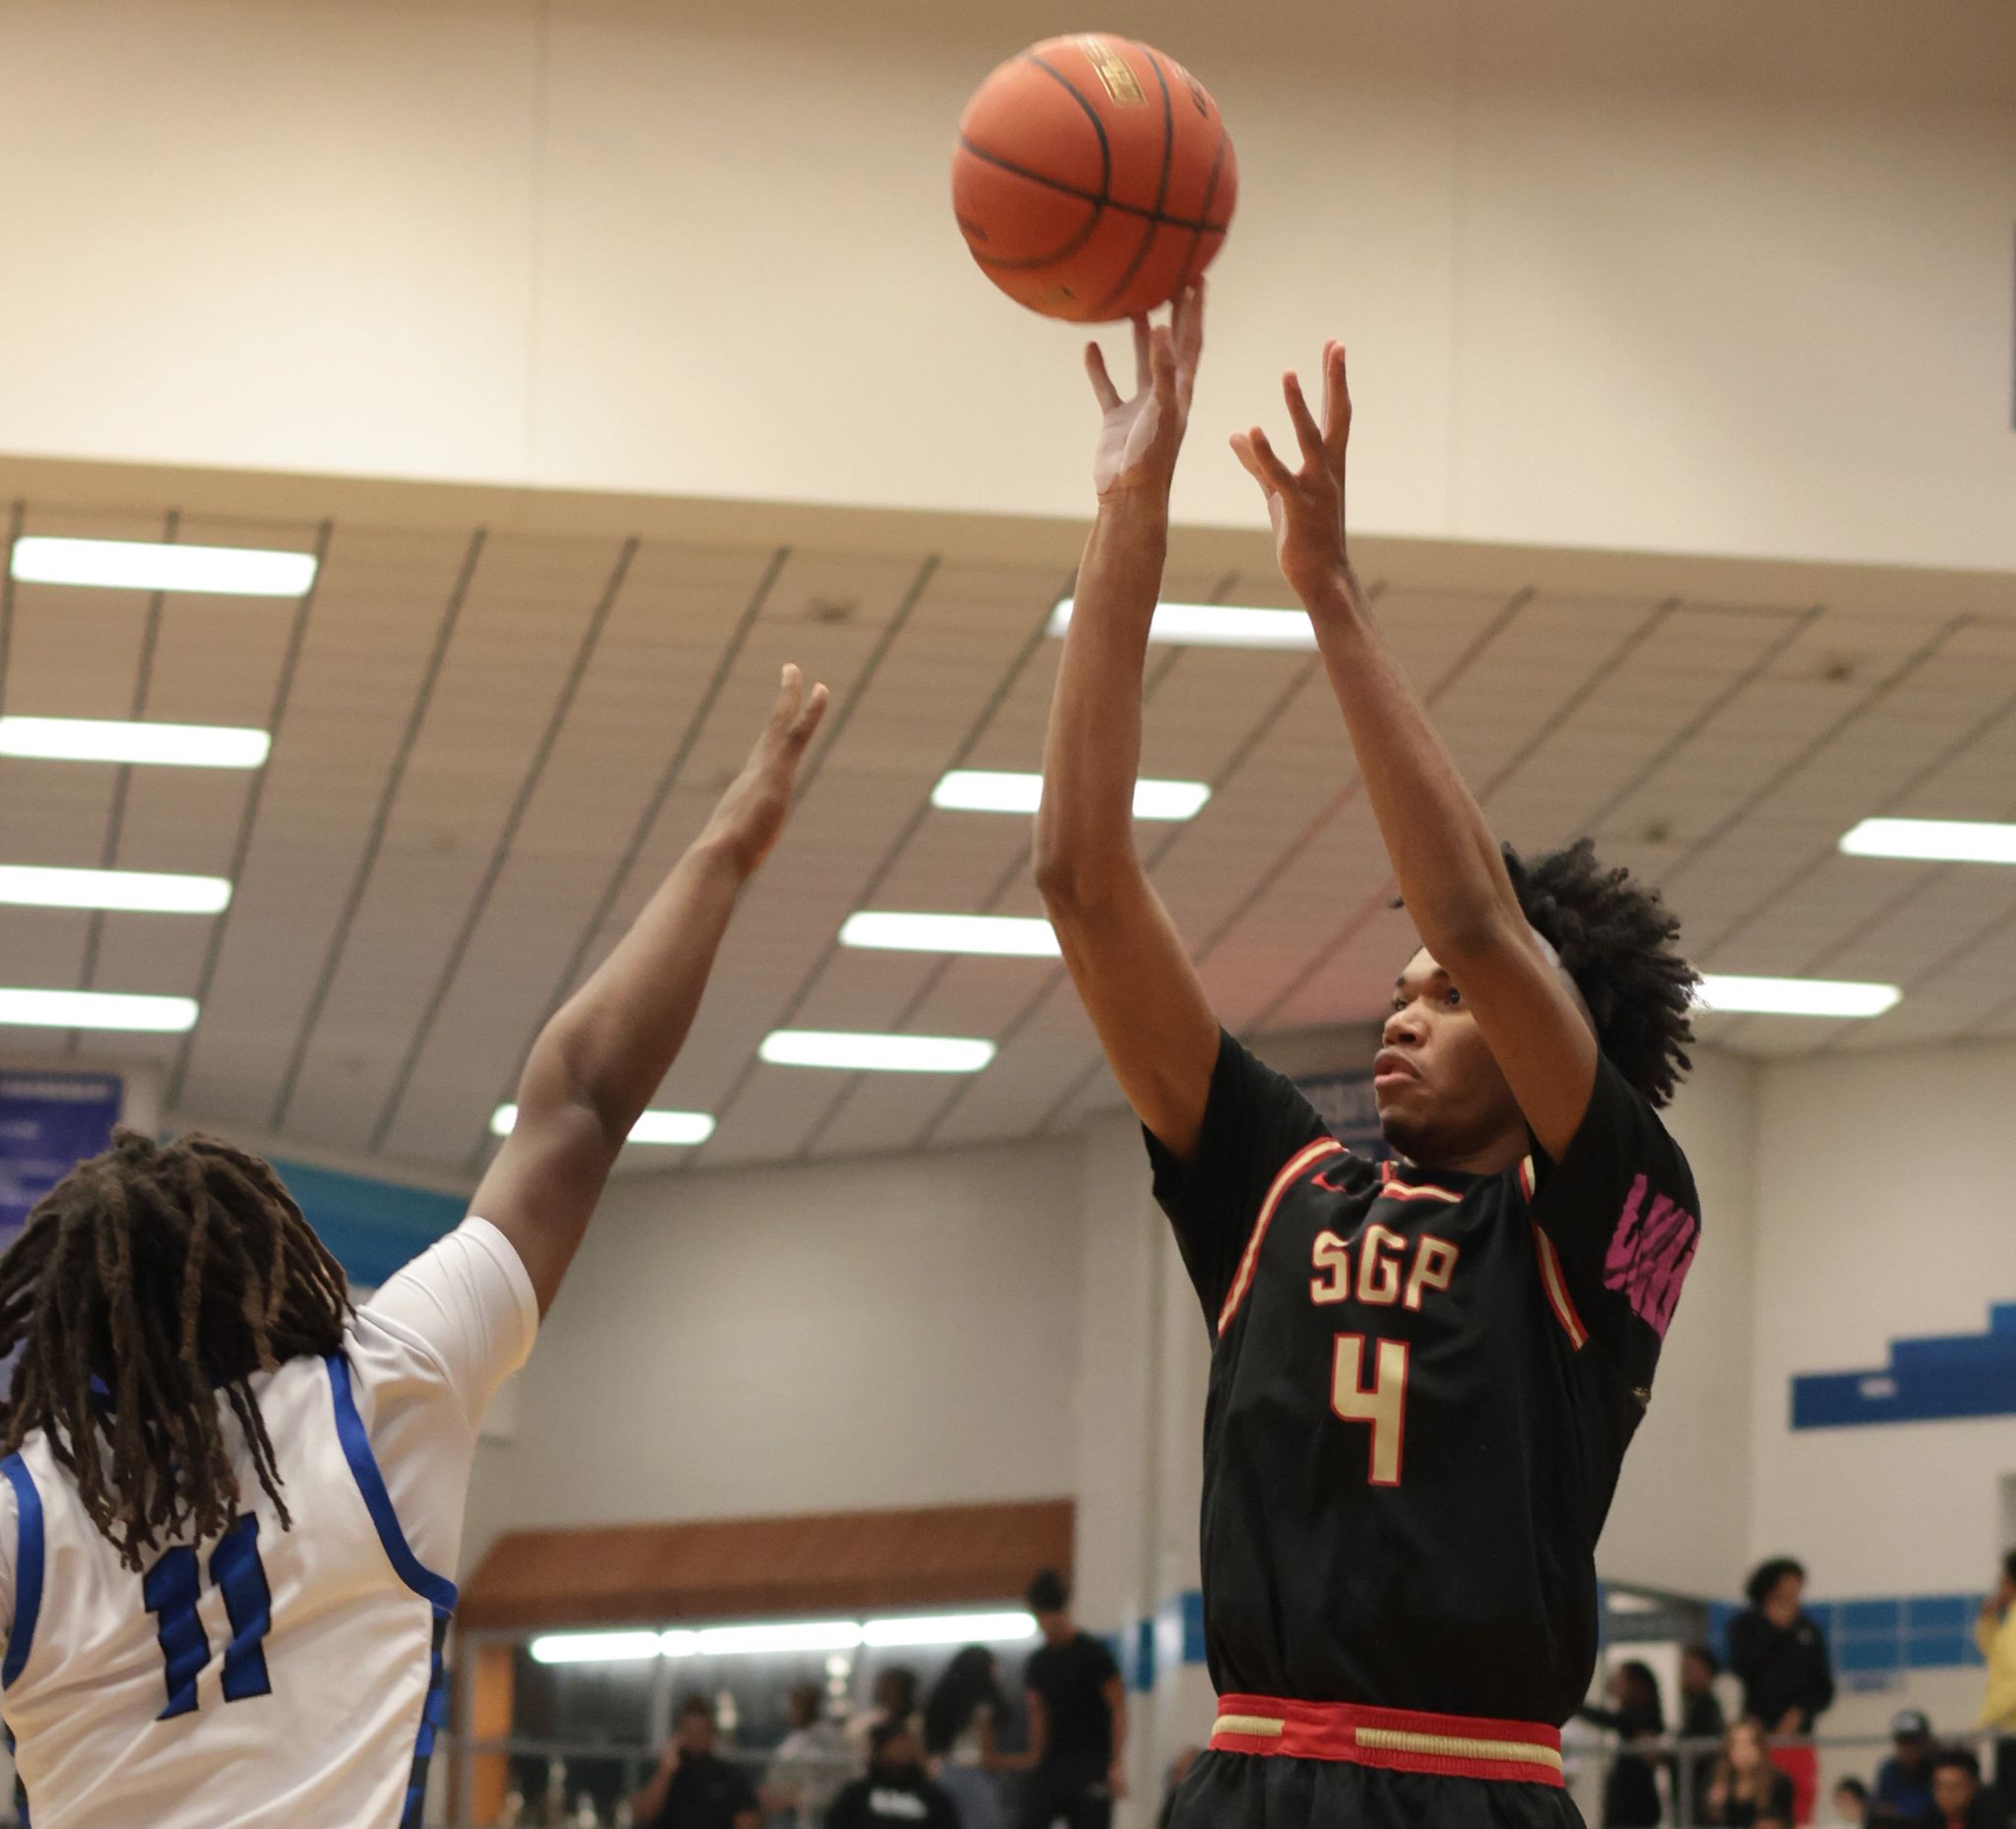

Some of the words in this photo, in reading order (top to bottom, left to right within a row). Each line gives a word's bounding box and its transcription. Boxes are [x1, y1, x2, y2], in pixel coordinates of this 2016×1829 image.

[1309, 1225, 1460, 1311] SGP
[1330, 1333, 1410, 1485] 4
[143, 1512, 272, 1720] 11
